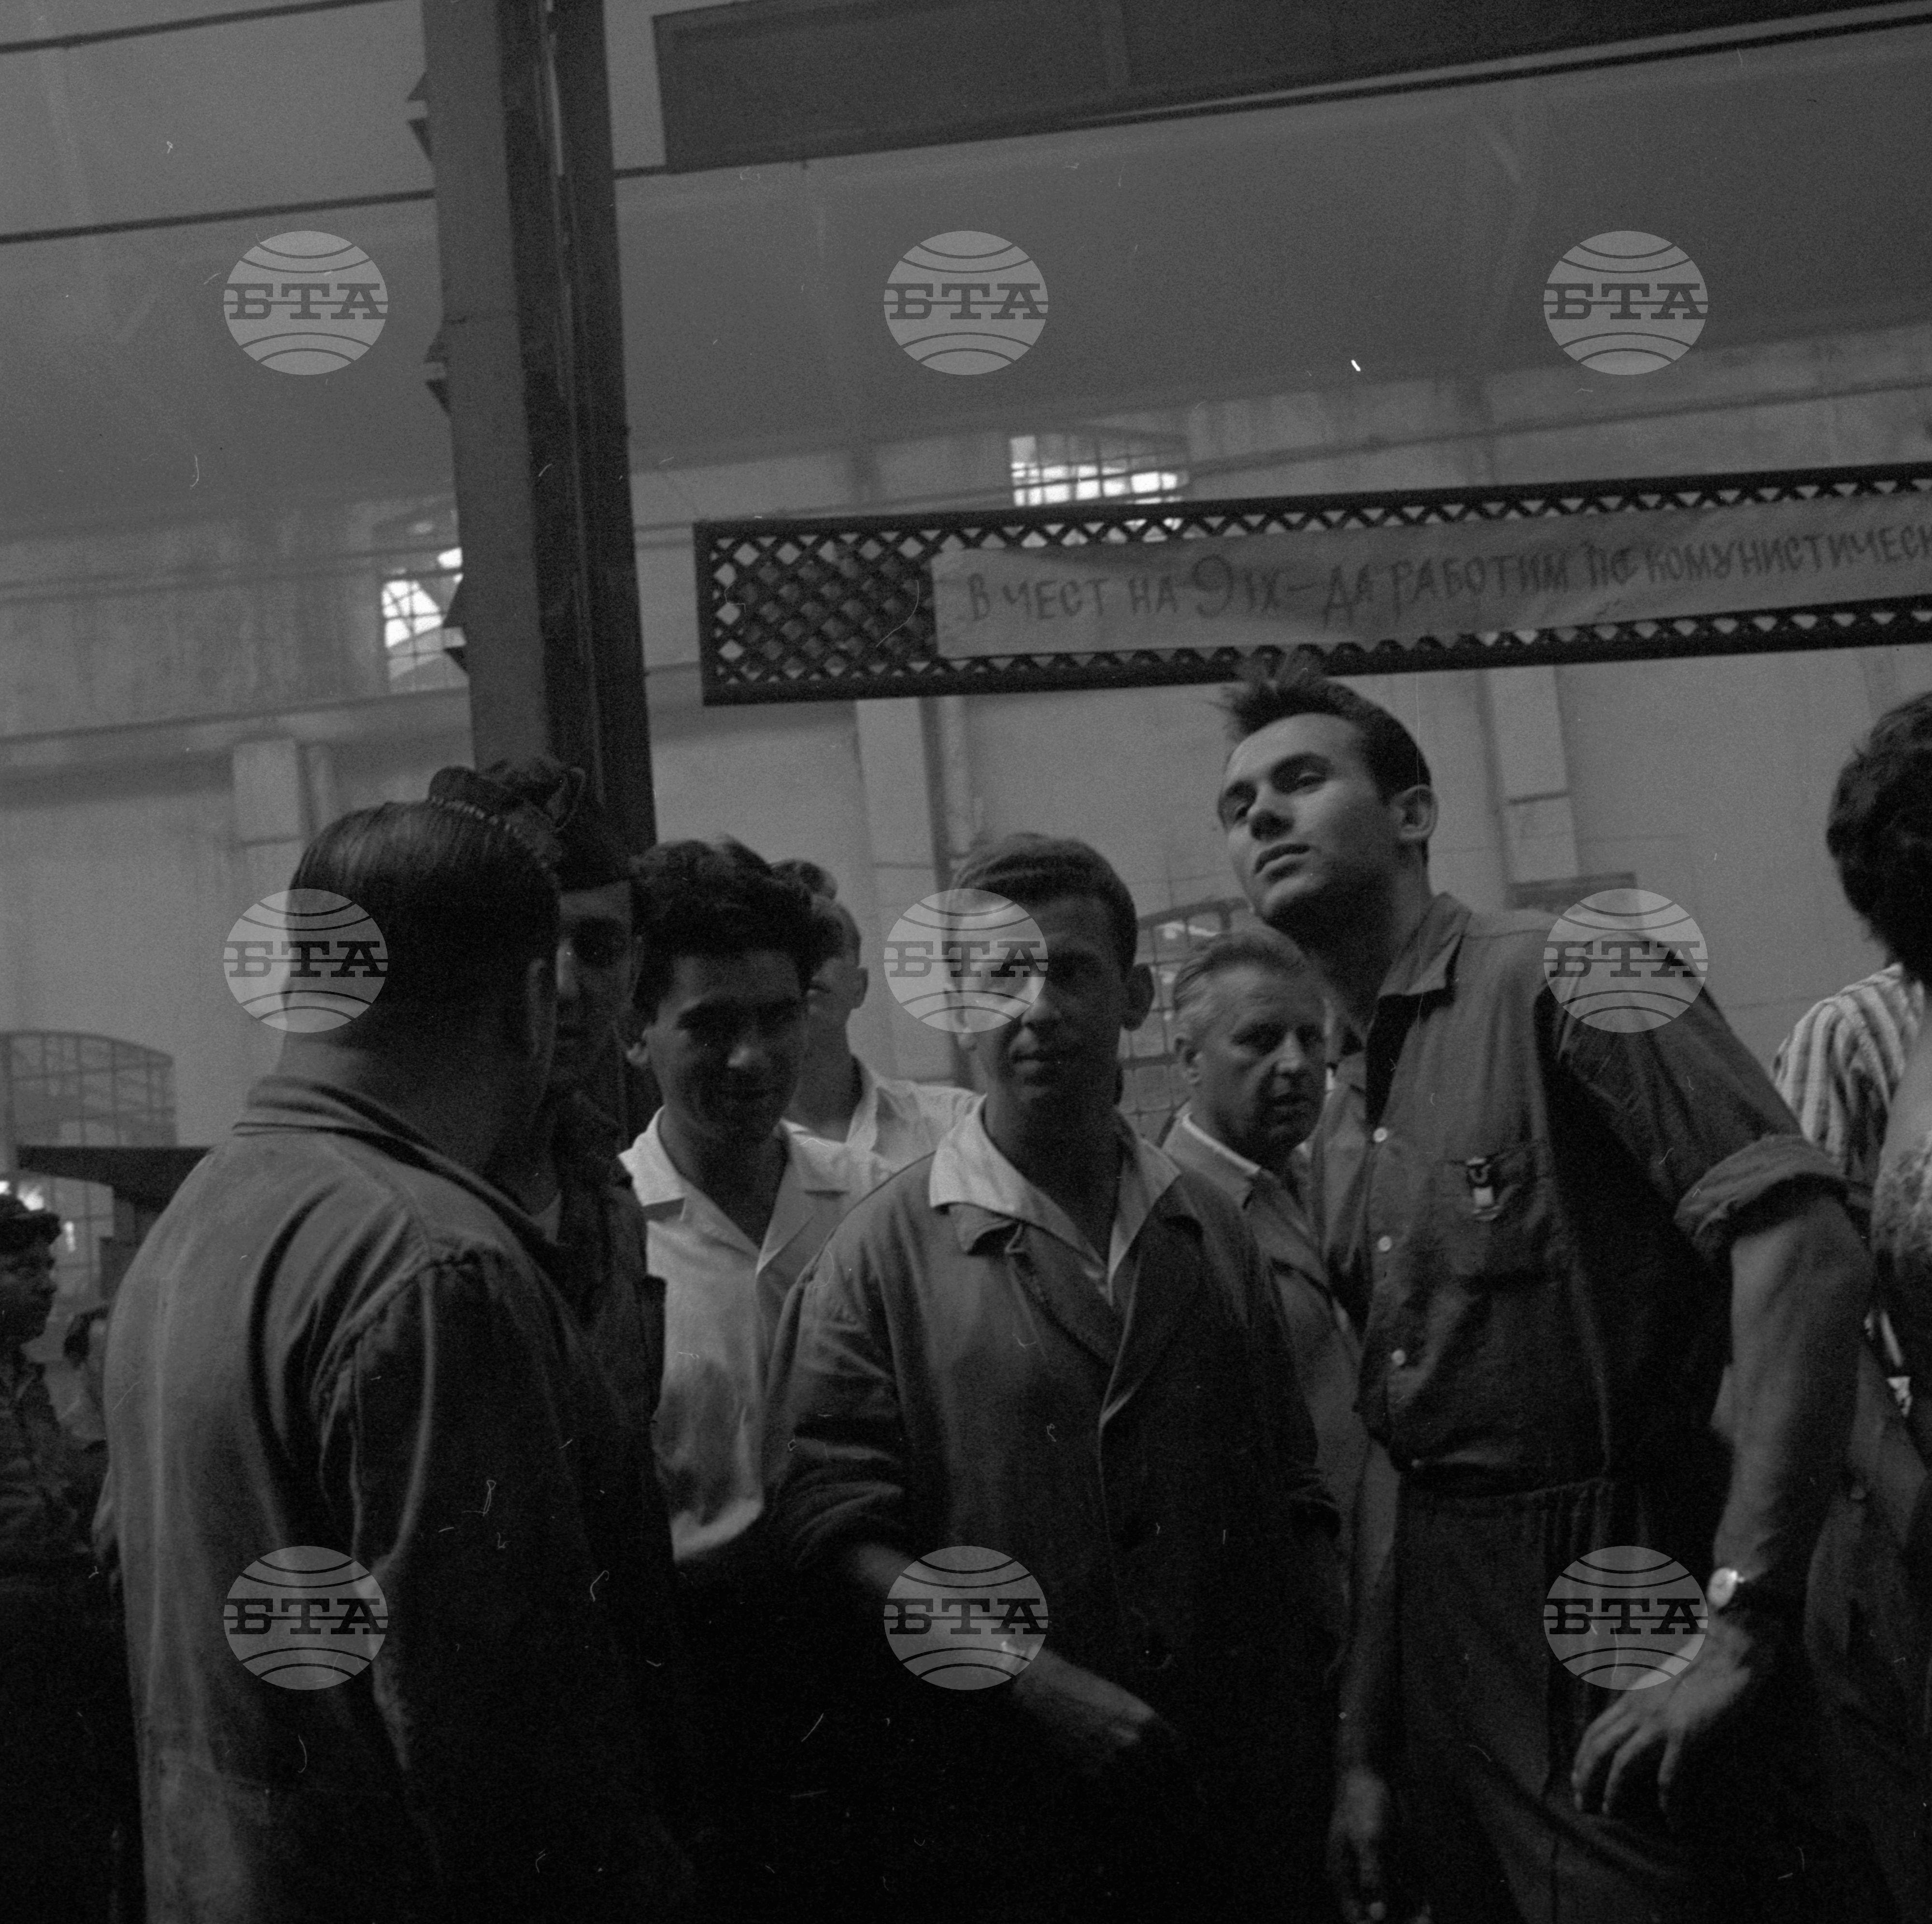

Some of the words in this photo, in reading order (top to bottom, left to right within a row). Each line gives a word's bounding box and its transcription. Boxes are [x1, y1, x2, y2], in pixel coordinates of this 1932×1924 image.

[966, 573, 992, 622] В
[1001, 578, 1109, 621] ЧЕСТ
[1128, 574, 1179, 615] НА
[1390, 548, 1571, 626] РАБОТИМ
